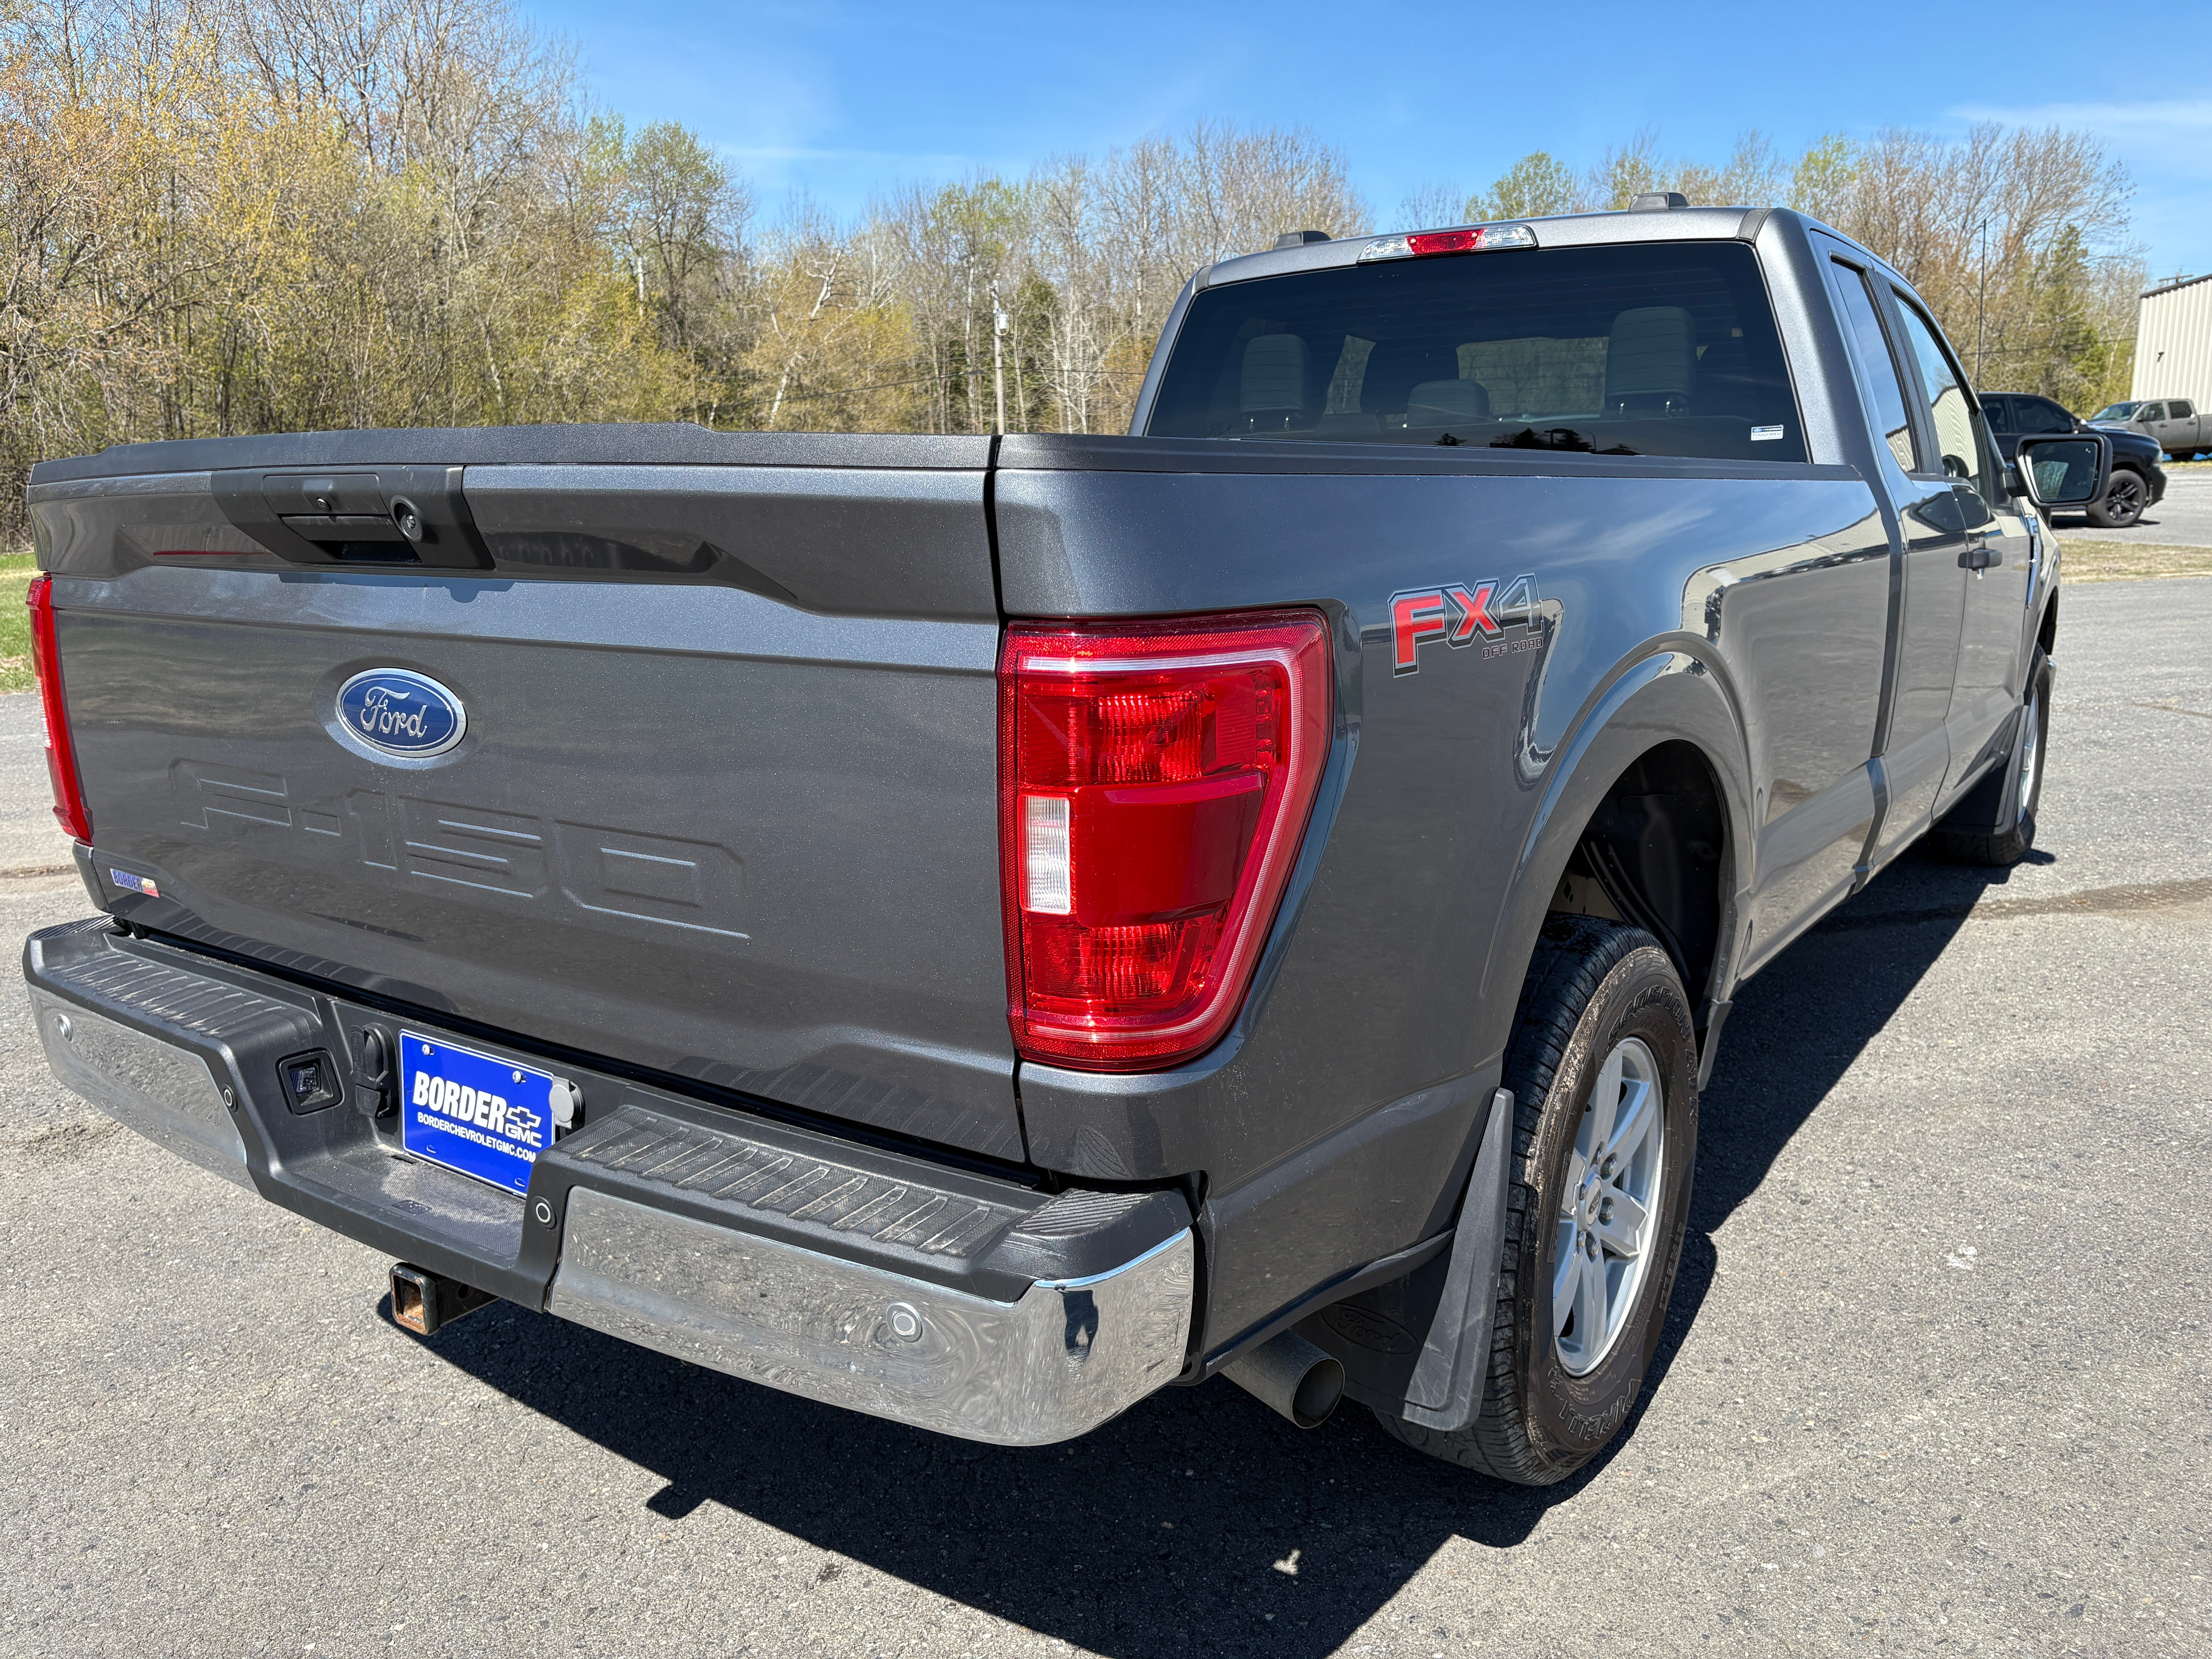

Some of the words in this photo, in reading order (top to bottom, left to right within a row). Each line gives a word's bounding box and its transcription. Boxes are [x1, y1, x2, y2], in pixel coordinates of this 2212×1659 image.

[1387, 573, 1543, 678] FX4
[1482, 643, 1508, 660] OFF
[1511, 636, 1544, 654] ROAD
[360, 686, 428, 738] Ford
[169, 757, 750, 939] F-150
[112, 870, 143, 891] BORDER
[1606, 984, 1692, 1054] SCORPION
[412, 1070, 507, 1133] BORDER
[417, 1111, 537, 1163] BORDERCHEVROLETGMC.COM
[505, 1123, 542, 1148] GMC
[1335, 1308, 1400, 1351] Ford
[1559, 1378, 1642, 1441] PIRELLI
